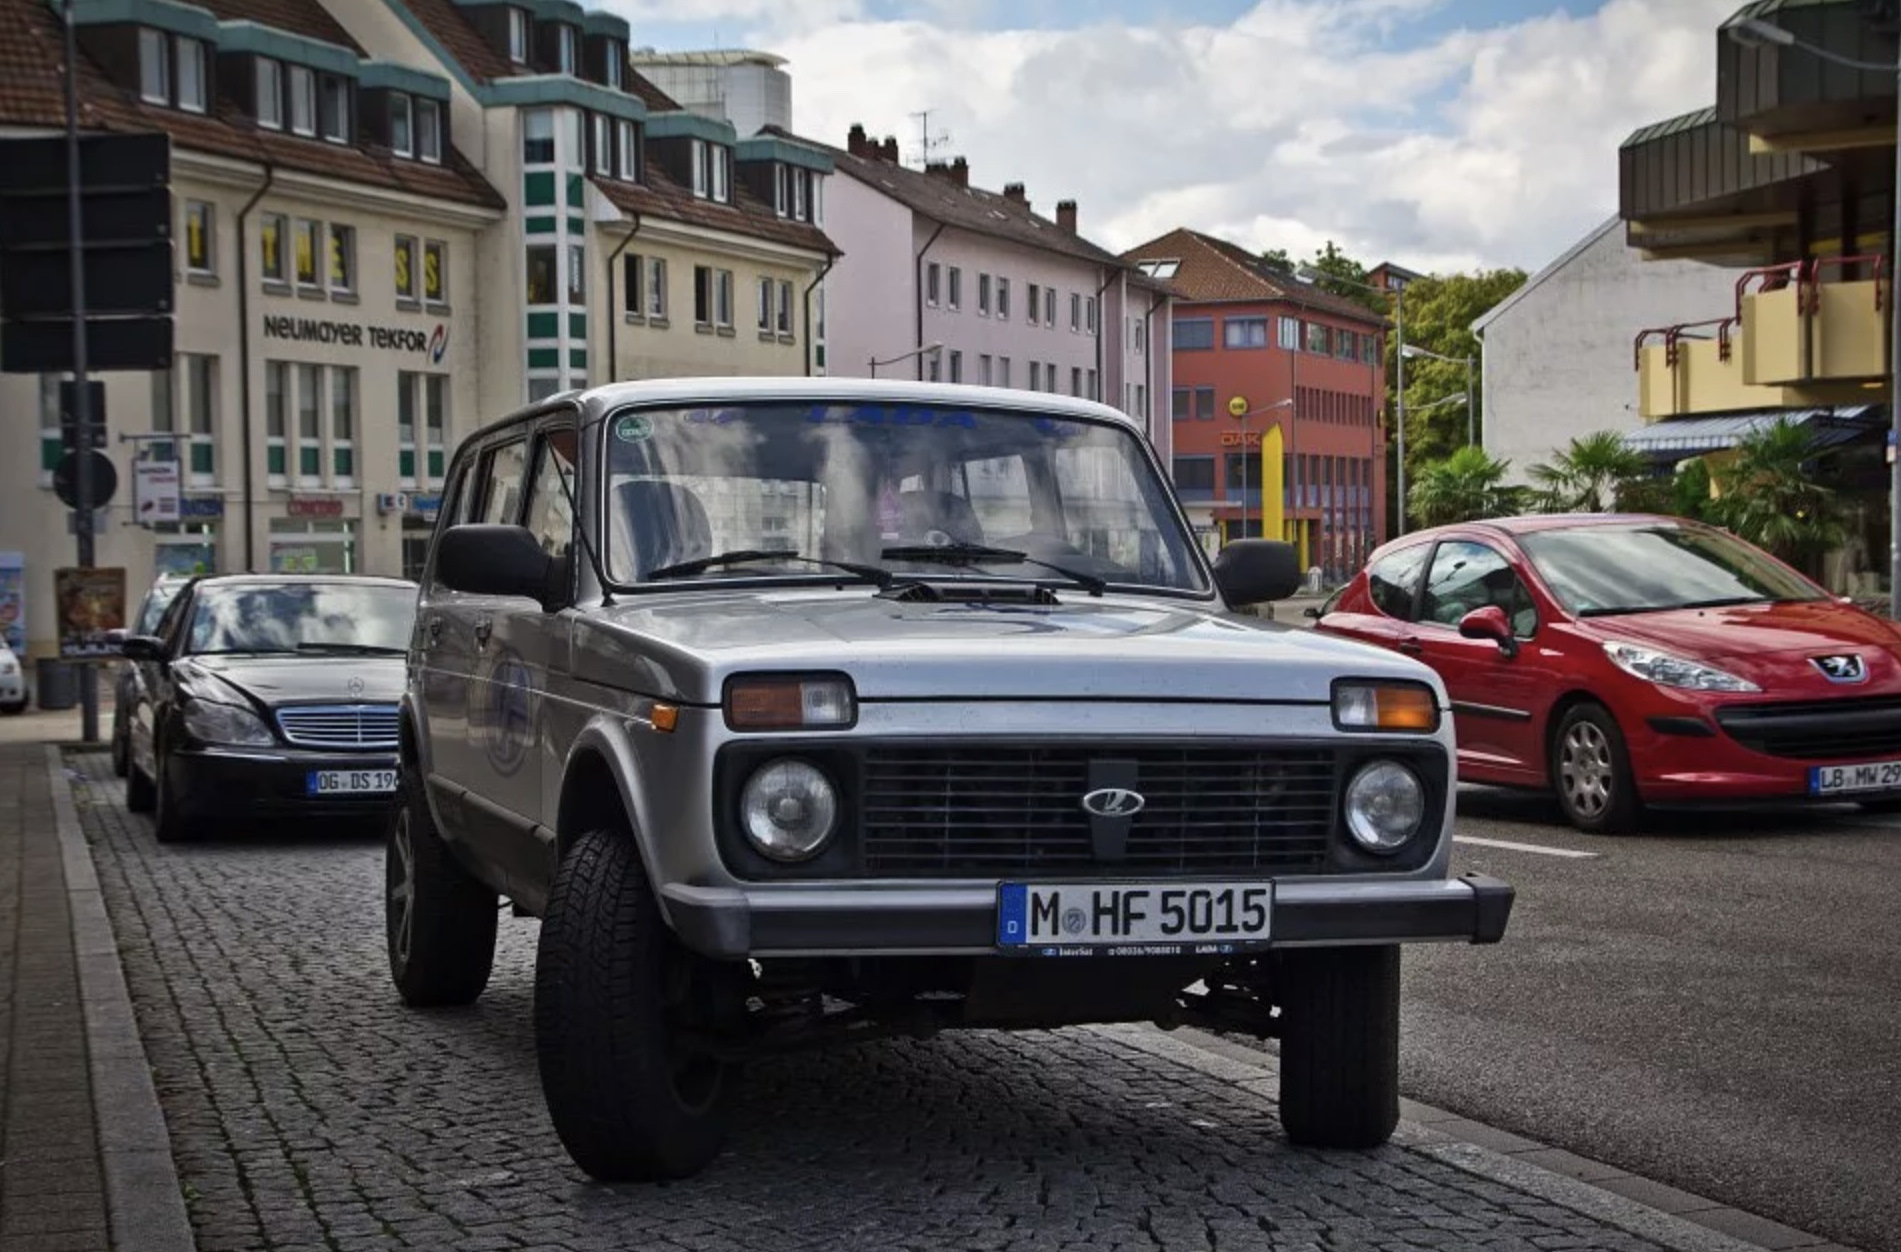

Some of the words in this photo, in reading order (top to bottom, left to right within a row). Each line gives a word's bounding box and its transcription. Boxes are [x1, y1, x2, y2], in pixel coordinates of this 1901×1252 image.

[351, 772, 370, 789] DS
[1821, 768, 1844, 788] LB
[1007, 921, 1018, 934] D
[1030, 891, 1060, 936] M
[1091, 891, 1149, 935] HF
[1160, 889, 1266, 934] 5015
